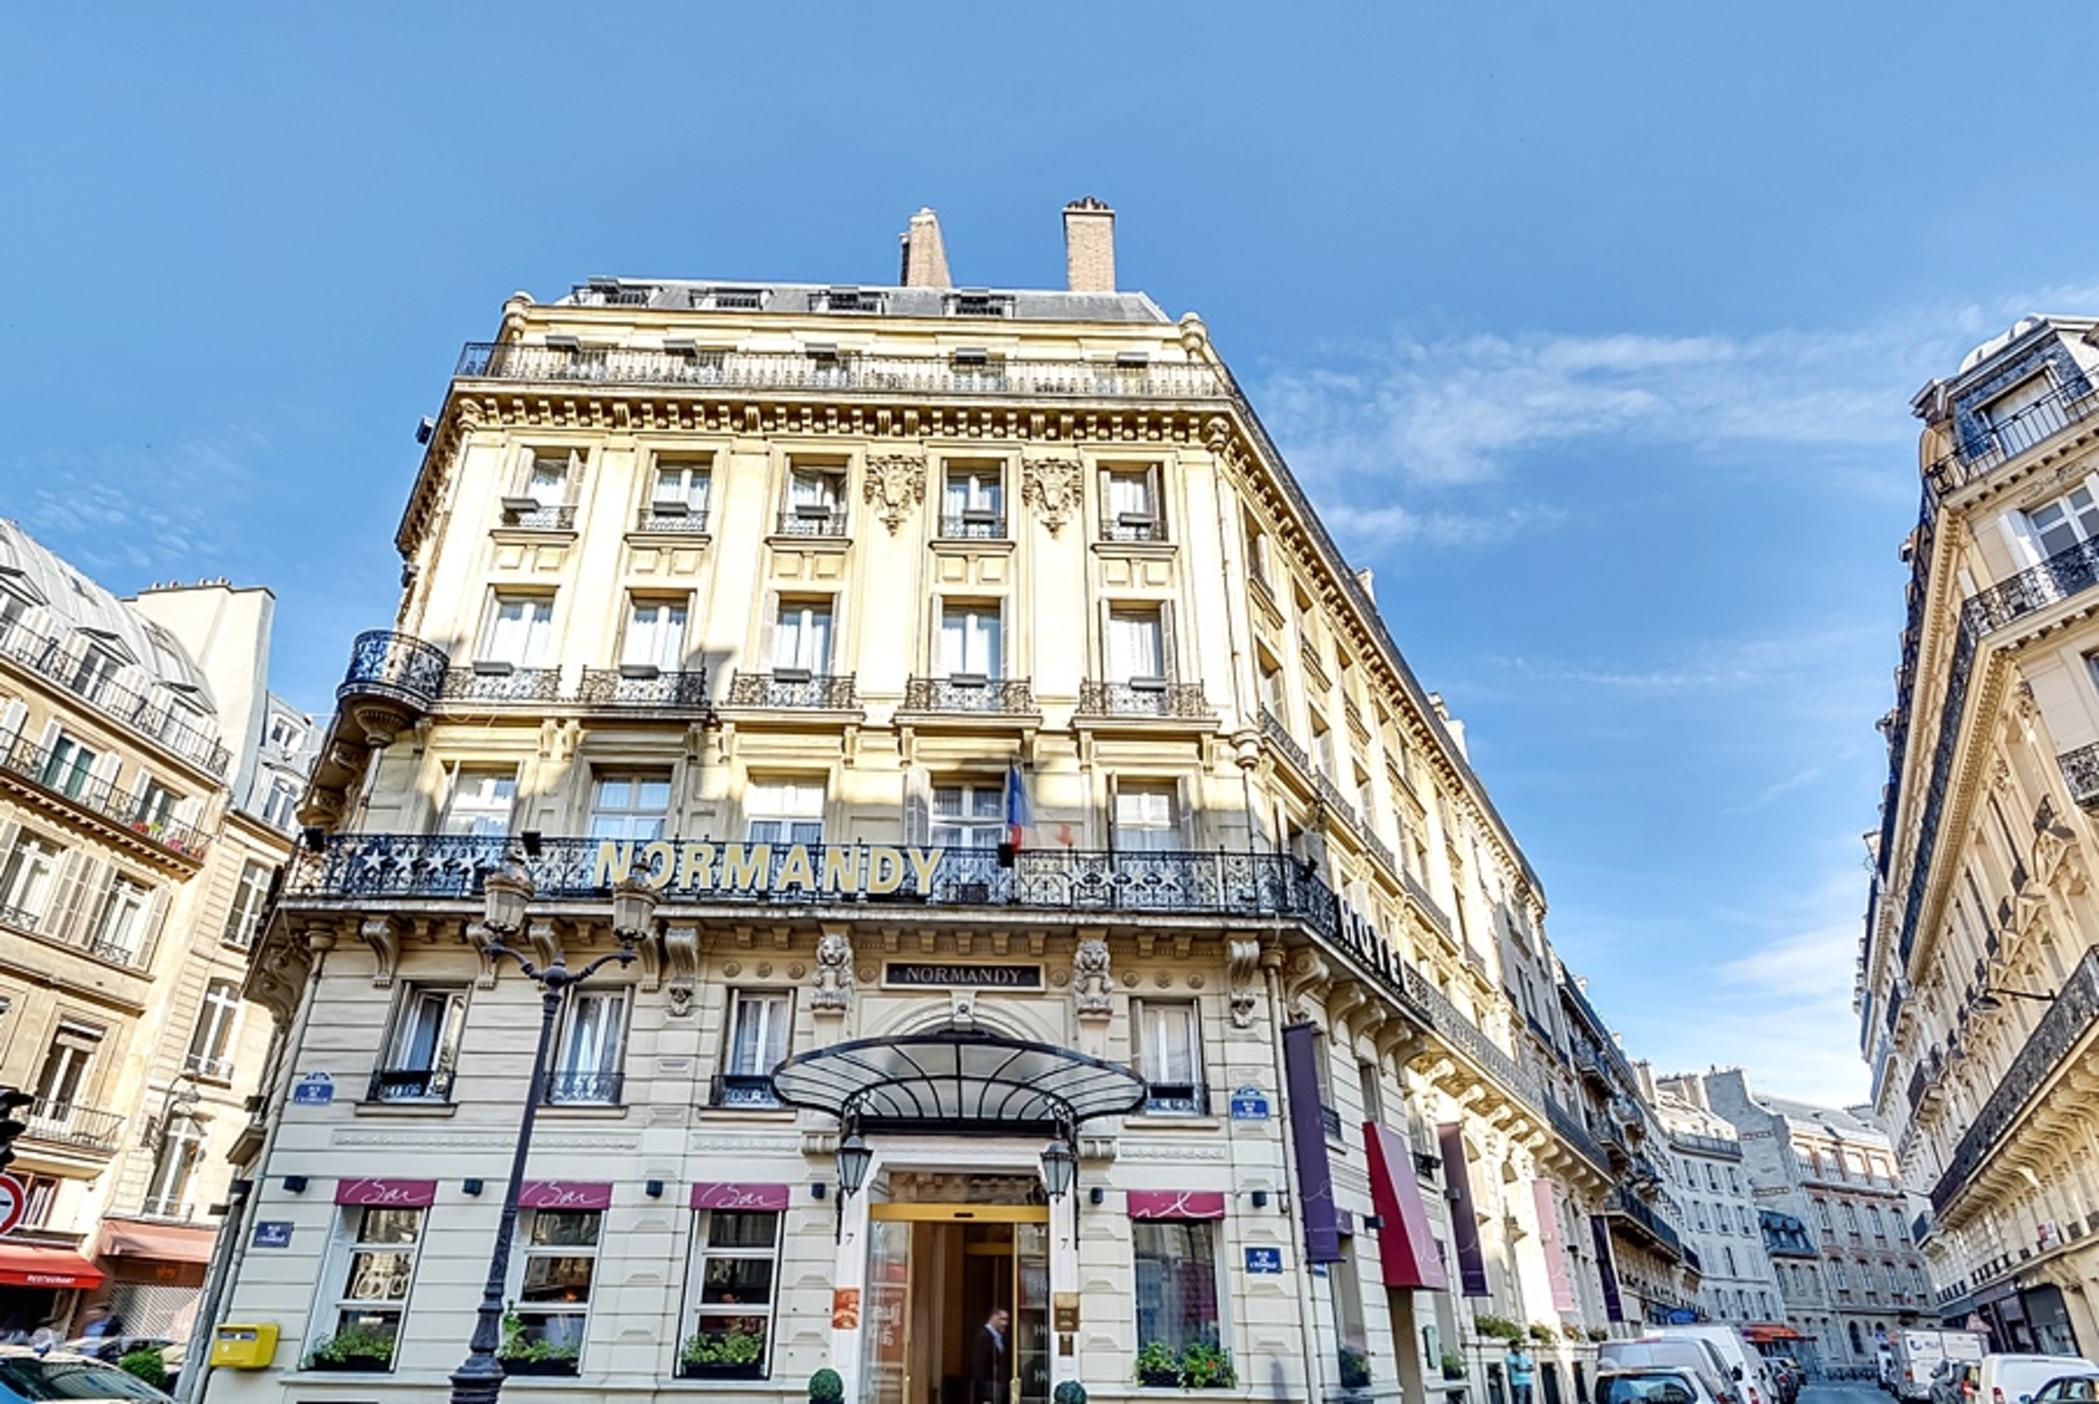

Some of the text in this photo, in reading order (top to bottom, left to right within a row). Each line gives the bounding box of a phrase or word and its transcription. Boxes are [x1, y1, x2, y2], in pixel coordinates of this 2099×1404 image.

[592, 841, 945, 895] NORMANDY
[905, 966, 1021, 984] NORMANDY
[345, 1177, 432, 1204] Bar
[521, 1180, 609, 1207] Bar
[701, 1183, 786, 1209] Bar
[845, 1233, 855, 1245] 7
[1060, 1238, 1069, 1250] 7
